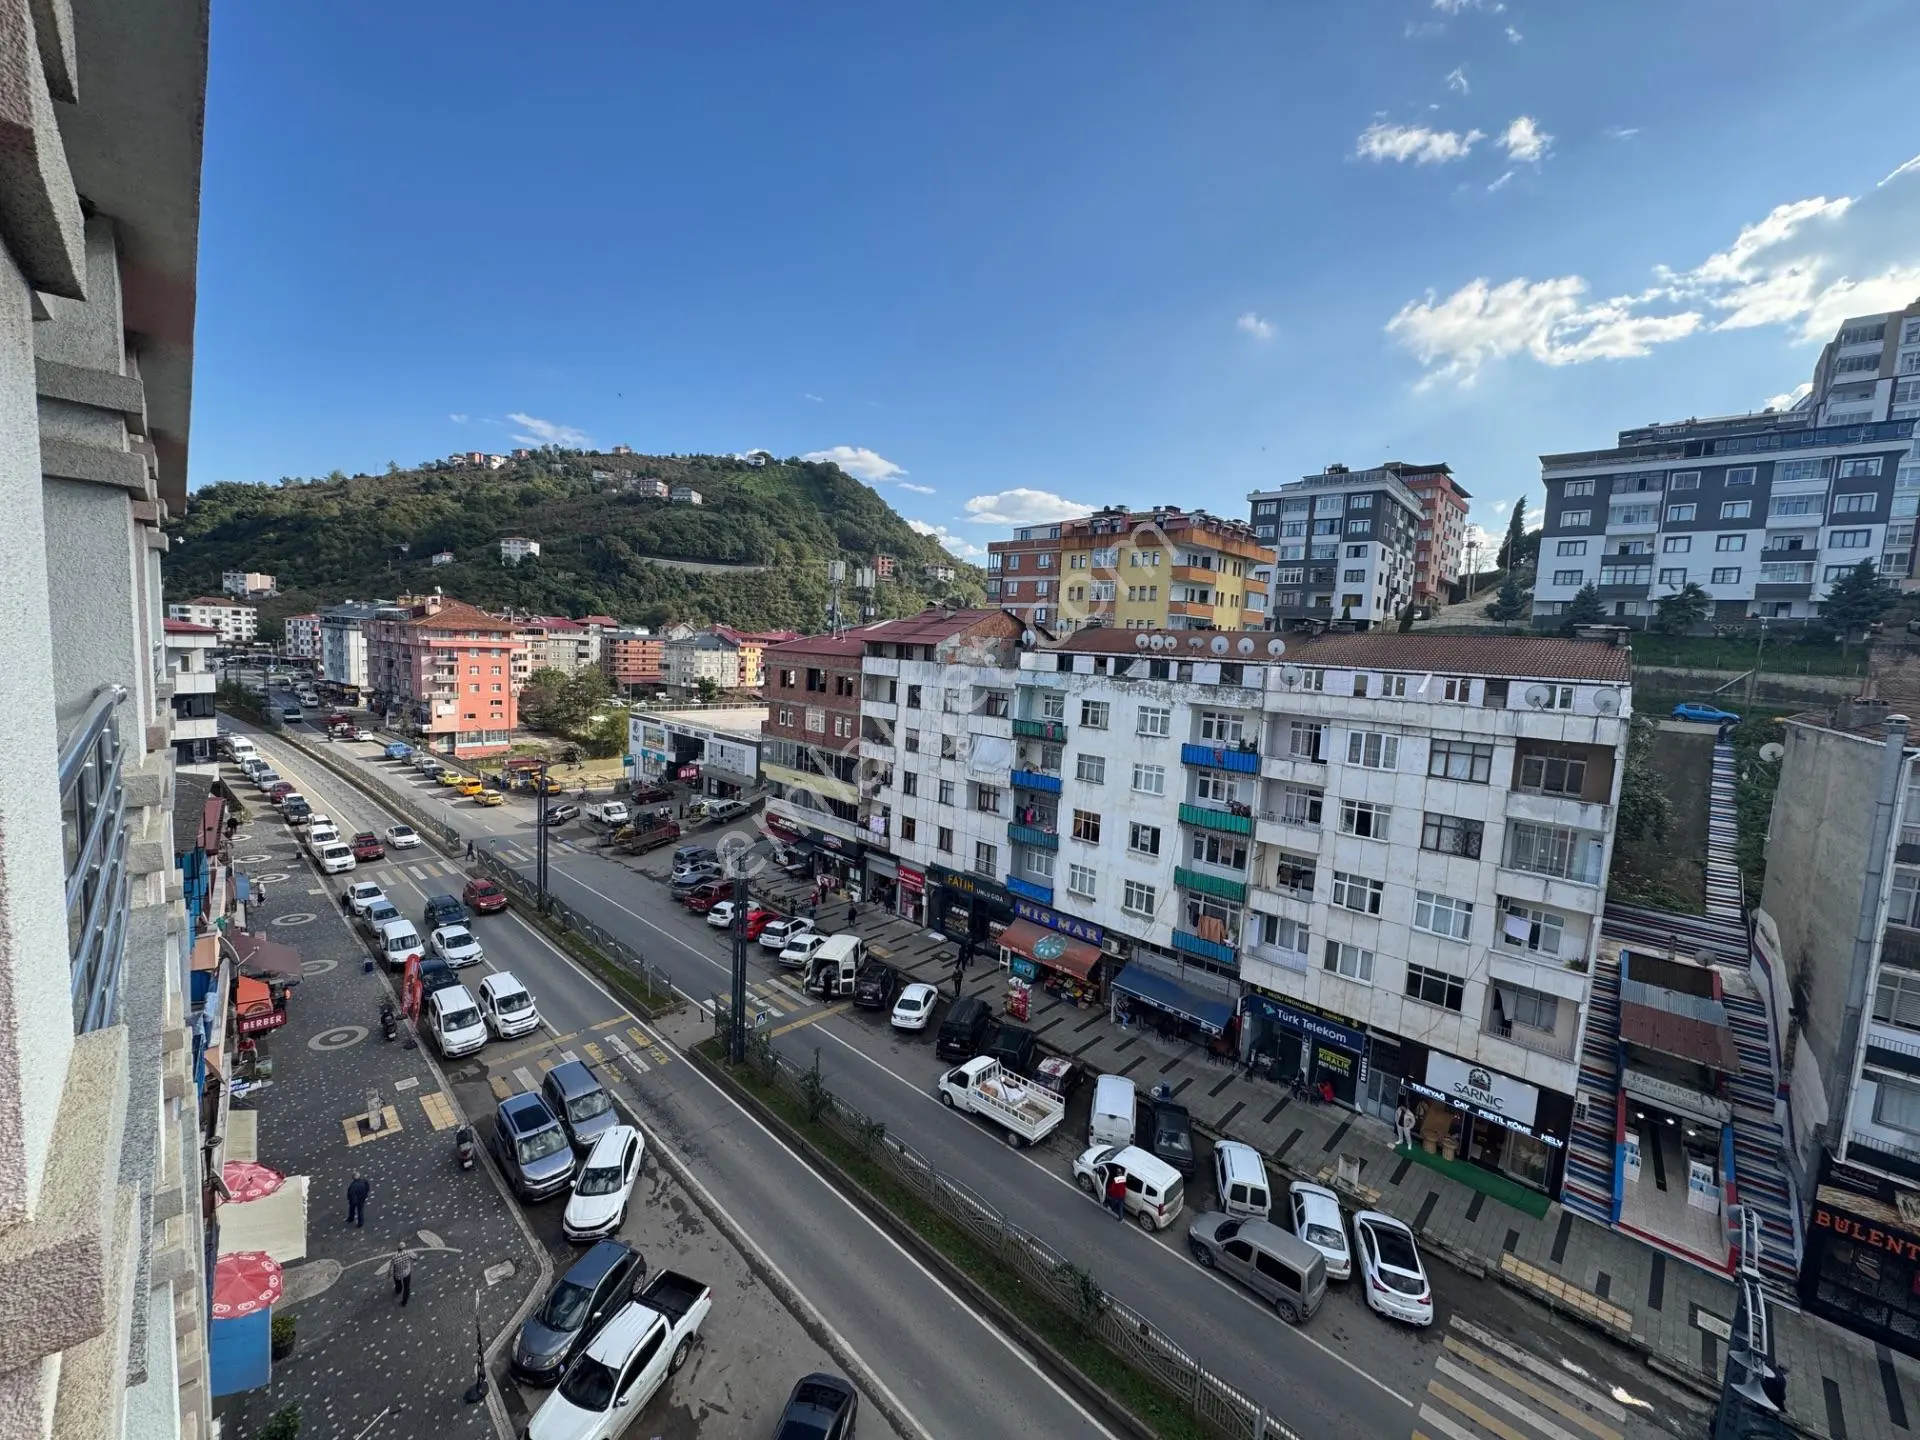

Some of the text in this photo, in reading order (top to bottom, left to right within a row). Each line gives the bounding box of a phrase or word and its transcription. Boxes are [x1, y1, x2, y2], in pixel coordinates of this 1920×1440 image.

[1057, 918, 1098, 941] MAR
[243, 1015, 282, 1030] BERBER
[1277, 1009, 1347, 1043] Türk Telekom
[1453, 1099, 1470, 1111] ÇAY
